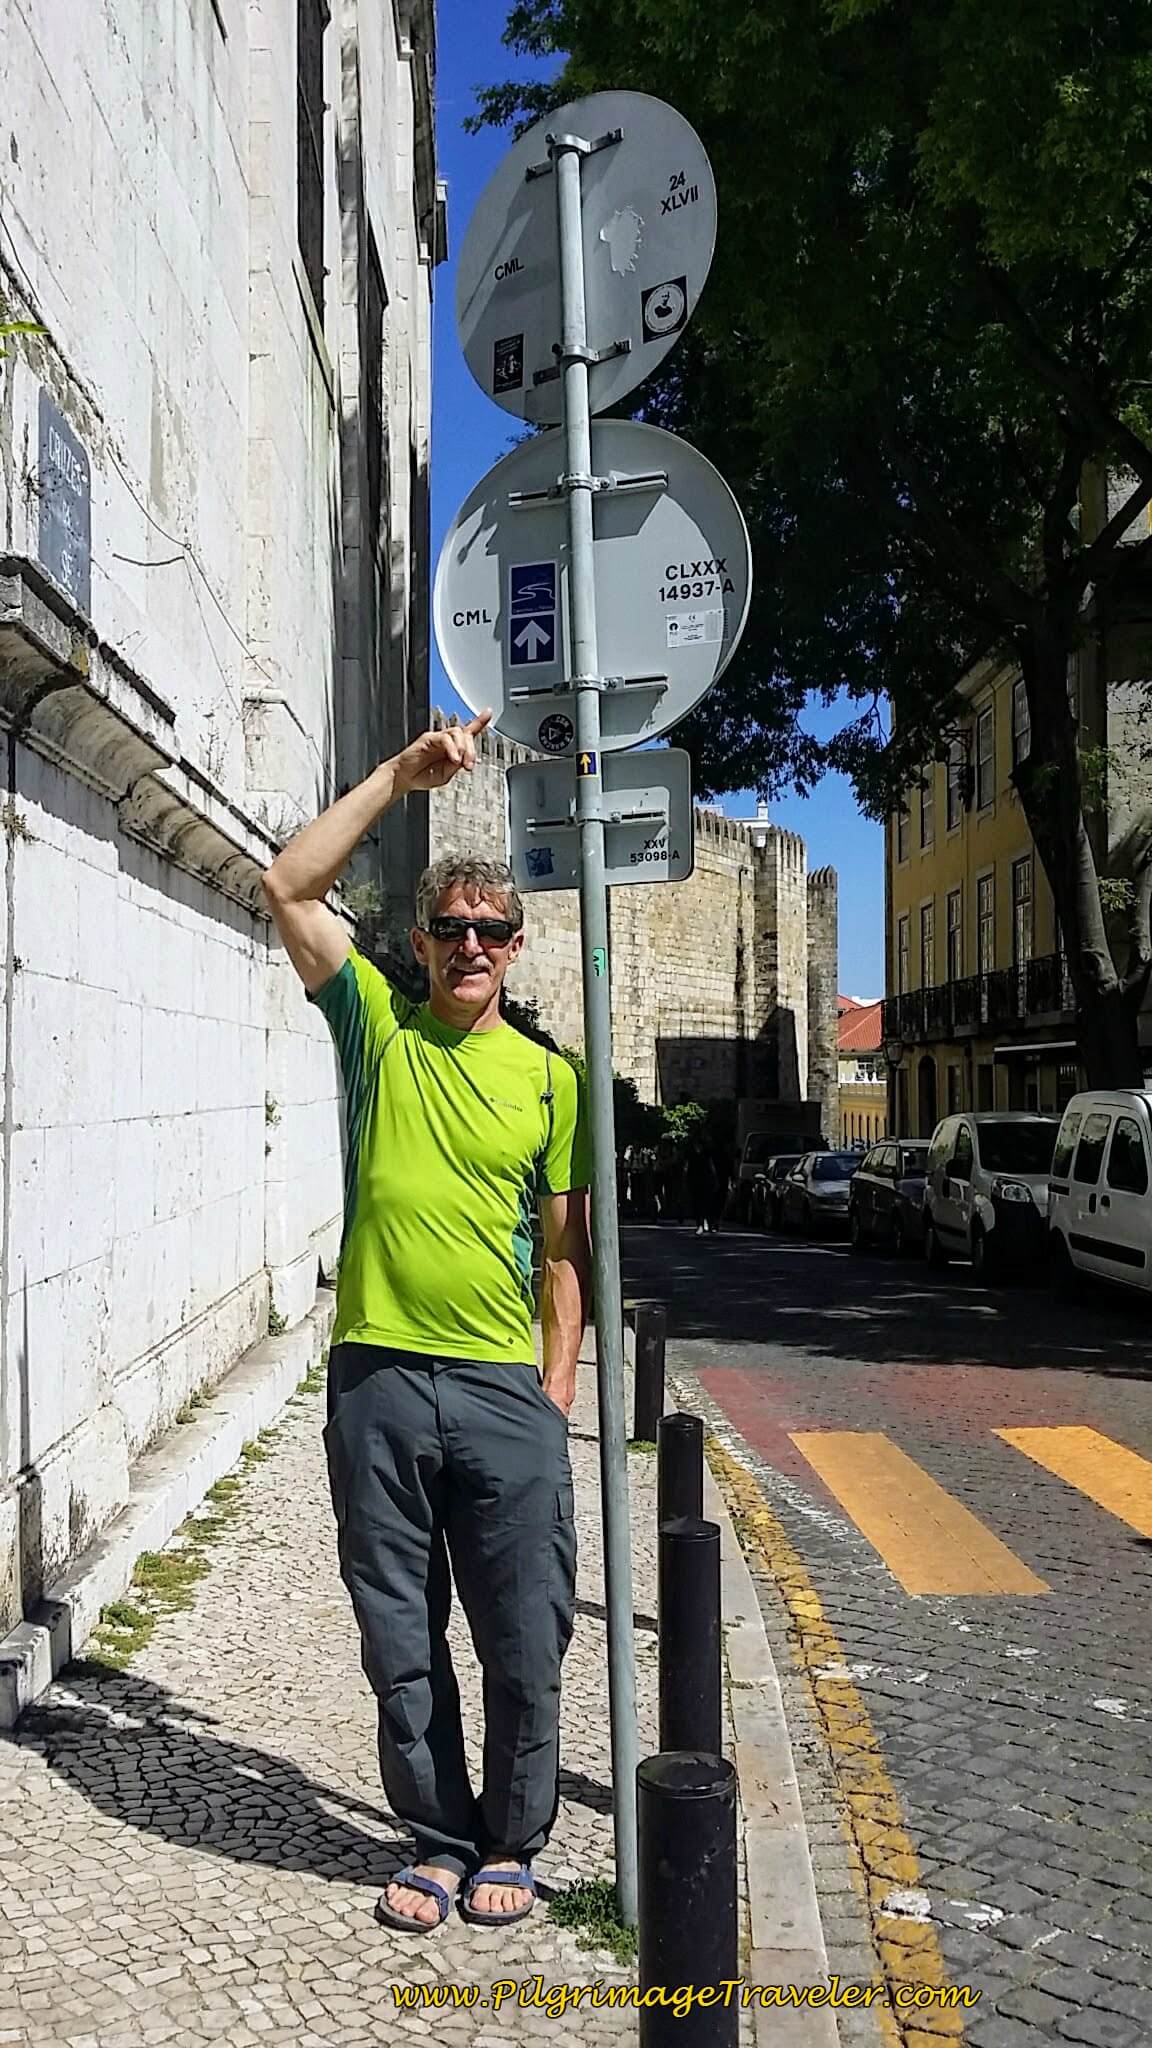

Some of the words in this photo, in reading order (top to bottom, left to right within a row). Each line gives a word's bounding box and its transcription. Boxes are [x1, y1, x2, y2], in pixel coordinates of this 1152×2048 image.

[669, 171, 686, 191] 24
[660, 185, 699, 216] XLVII
[494, 258, 525, 281] CML
[665, 558, 728, 580] CLXXX
[659, 578, 735, 602] 14937-A
[453, 609, 492, 627] CML
[643, 838, 666, 849] XXV
[630, 850, 680, 864] 53098-A
